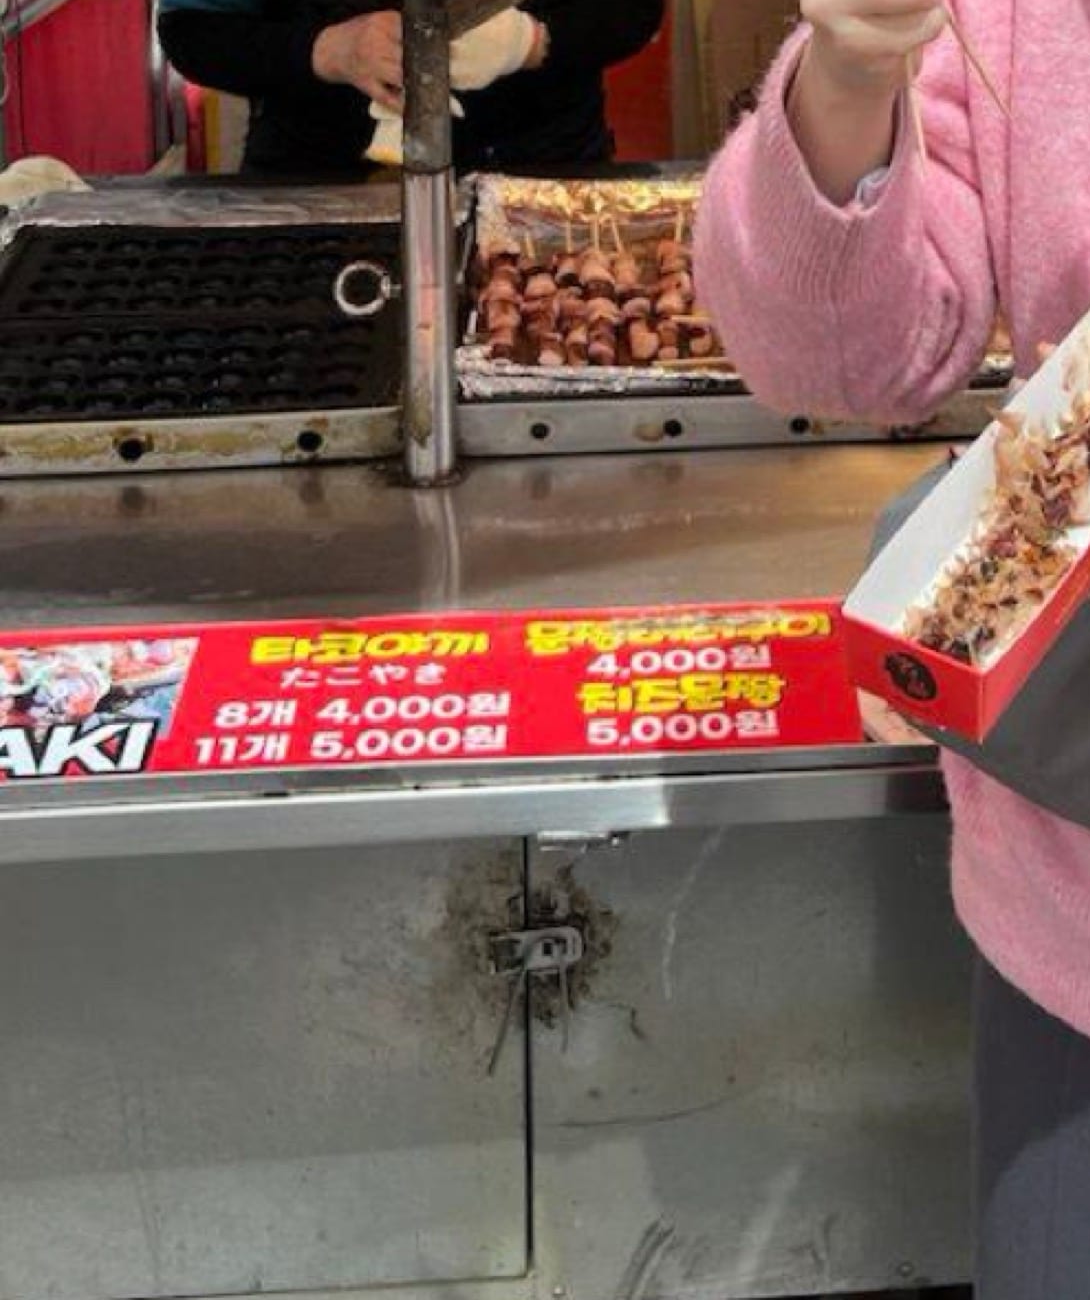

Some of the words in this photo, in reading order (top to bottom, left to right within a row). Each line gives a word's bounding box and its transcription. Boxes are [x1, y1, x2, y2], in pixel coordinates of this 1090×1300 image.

[251, 632, 489, 662] 타코야끼
[587, 645, 770, 675] 4,000원
[280, 663, 446, 687] たこやき
[214, 700, 296, 728] 8개
[587, 711, 778, 744] 5,000원
[195, 734, 290, 763] 11개
[310, 725, 507, 758] 5,000원
